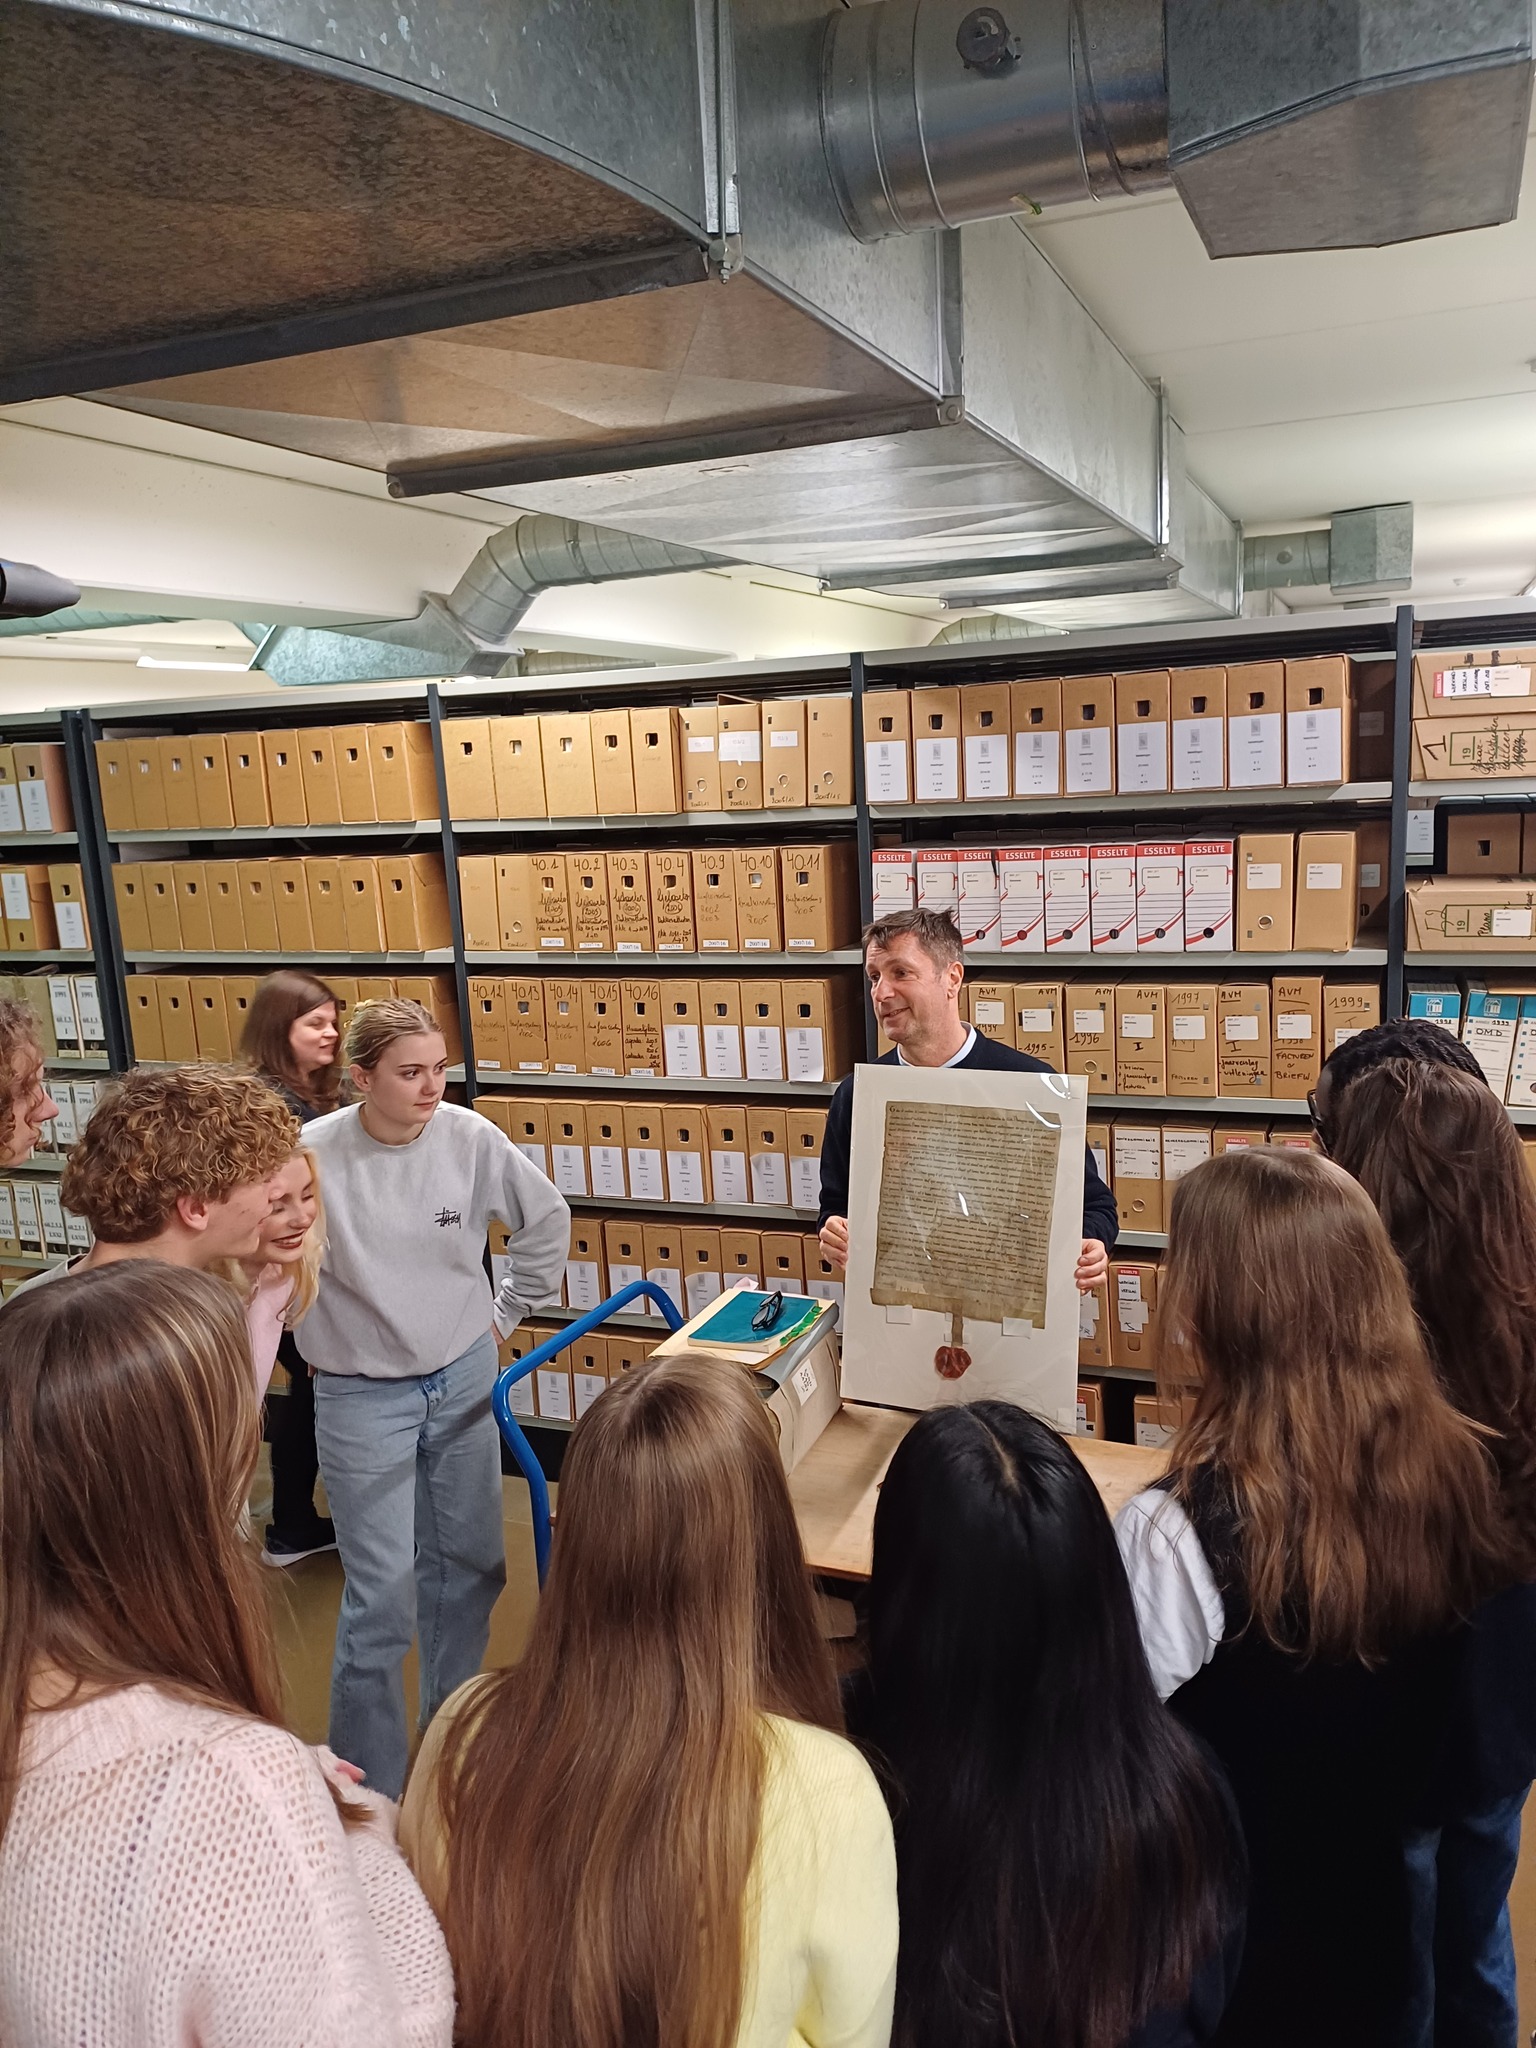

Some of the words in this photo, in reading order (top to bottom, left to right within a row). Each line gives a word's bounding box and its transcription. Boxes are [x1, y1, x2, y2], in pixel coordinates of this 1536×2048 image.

[1462, 747, 1472, 760] 19
[1050, 849, 1082, 858] ESSELTE
[1097, 848, 1129, 857] ESSELTE
[1143, 846, 1176, 855] ESSELTE
[1192, 845, 1225, 854] ESSELTE
[700, 854, 725, 870] 40.9
[740, 852, 773, 871] 40.10
[878, 853, 906, 862] ESSELTE
[923, 853, 952, 861] ESSELTE
[1005, 852, 1036, 860] ESSELTE
[531, 858, 559, 871] 40.1
[573, 857, 601, 872] 40.2
[612, 856, 639, 871] 40.3
[656, 855, 684, 877] 40.4
[1457, 920, 1466, 932] 19
[472, 982, 503, 999] 40.12
[549, 982, 578, 1003] 40.14
[978, 987, 997, 995] AVM
[1038, 988, 1058, 996] AVM
[1136, 989, 1158, 999] AVM
[1221, 990, 1242, 999] AVM
[1278, 986, 1302, 997] AVM
[1171, 991, 1200, 1006] 1997
[1328, 996, 1363, 1009] 1999
[1069, 1032, 1100, 1046] 1996
